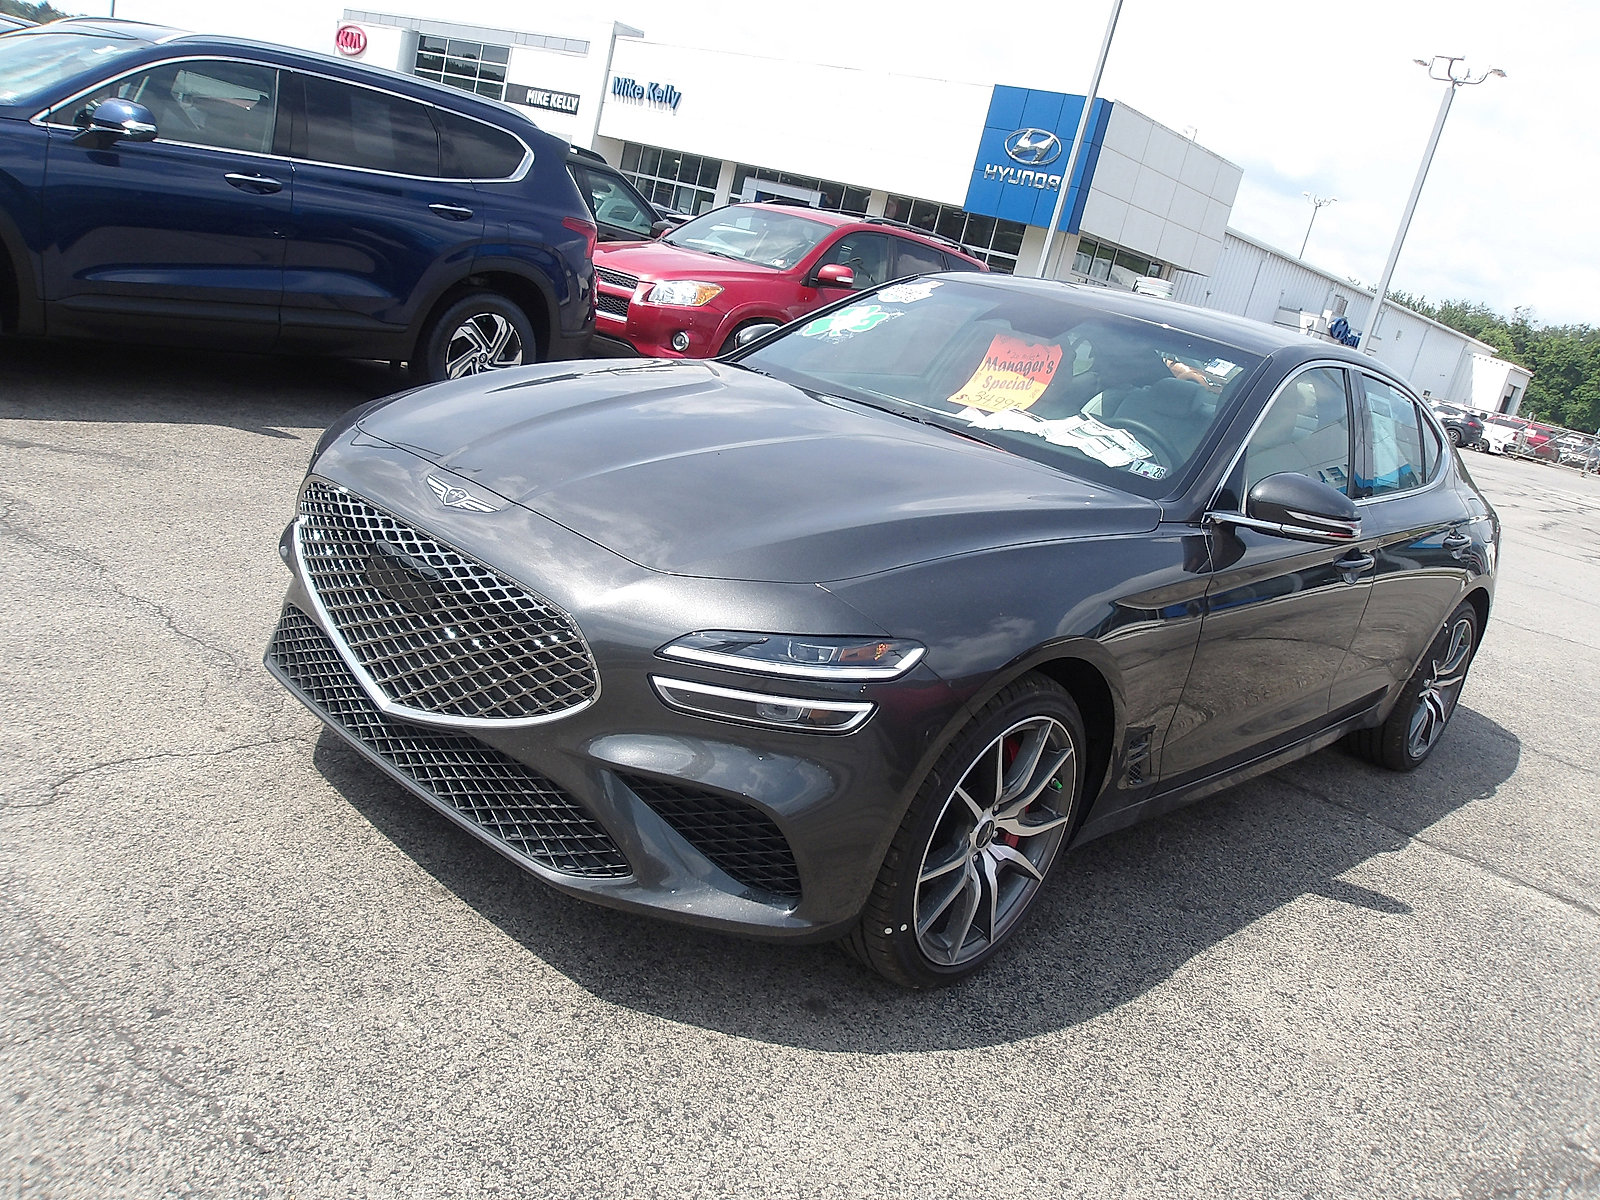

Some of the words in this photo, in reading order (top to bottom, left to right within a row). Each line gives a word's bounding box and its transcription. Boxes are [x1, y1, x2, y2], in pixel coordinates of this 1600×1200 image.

[525, 89, 550, 107] MIKE
[549, 93, 579, 111] KELLY
[611, 76, 645, 99] Mike
[646, 82, 682, 110] Kelly
[983, 163, 1062, 192] HYUNDA
[981, 353, 1055, 377] Manager's
[982, 375, 1035, 392] Special
[1135, 461, 1145, 471] 7
[1152, 467, 1165, 479] 26
